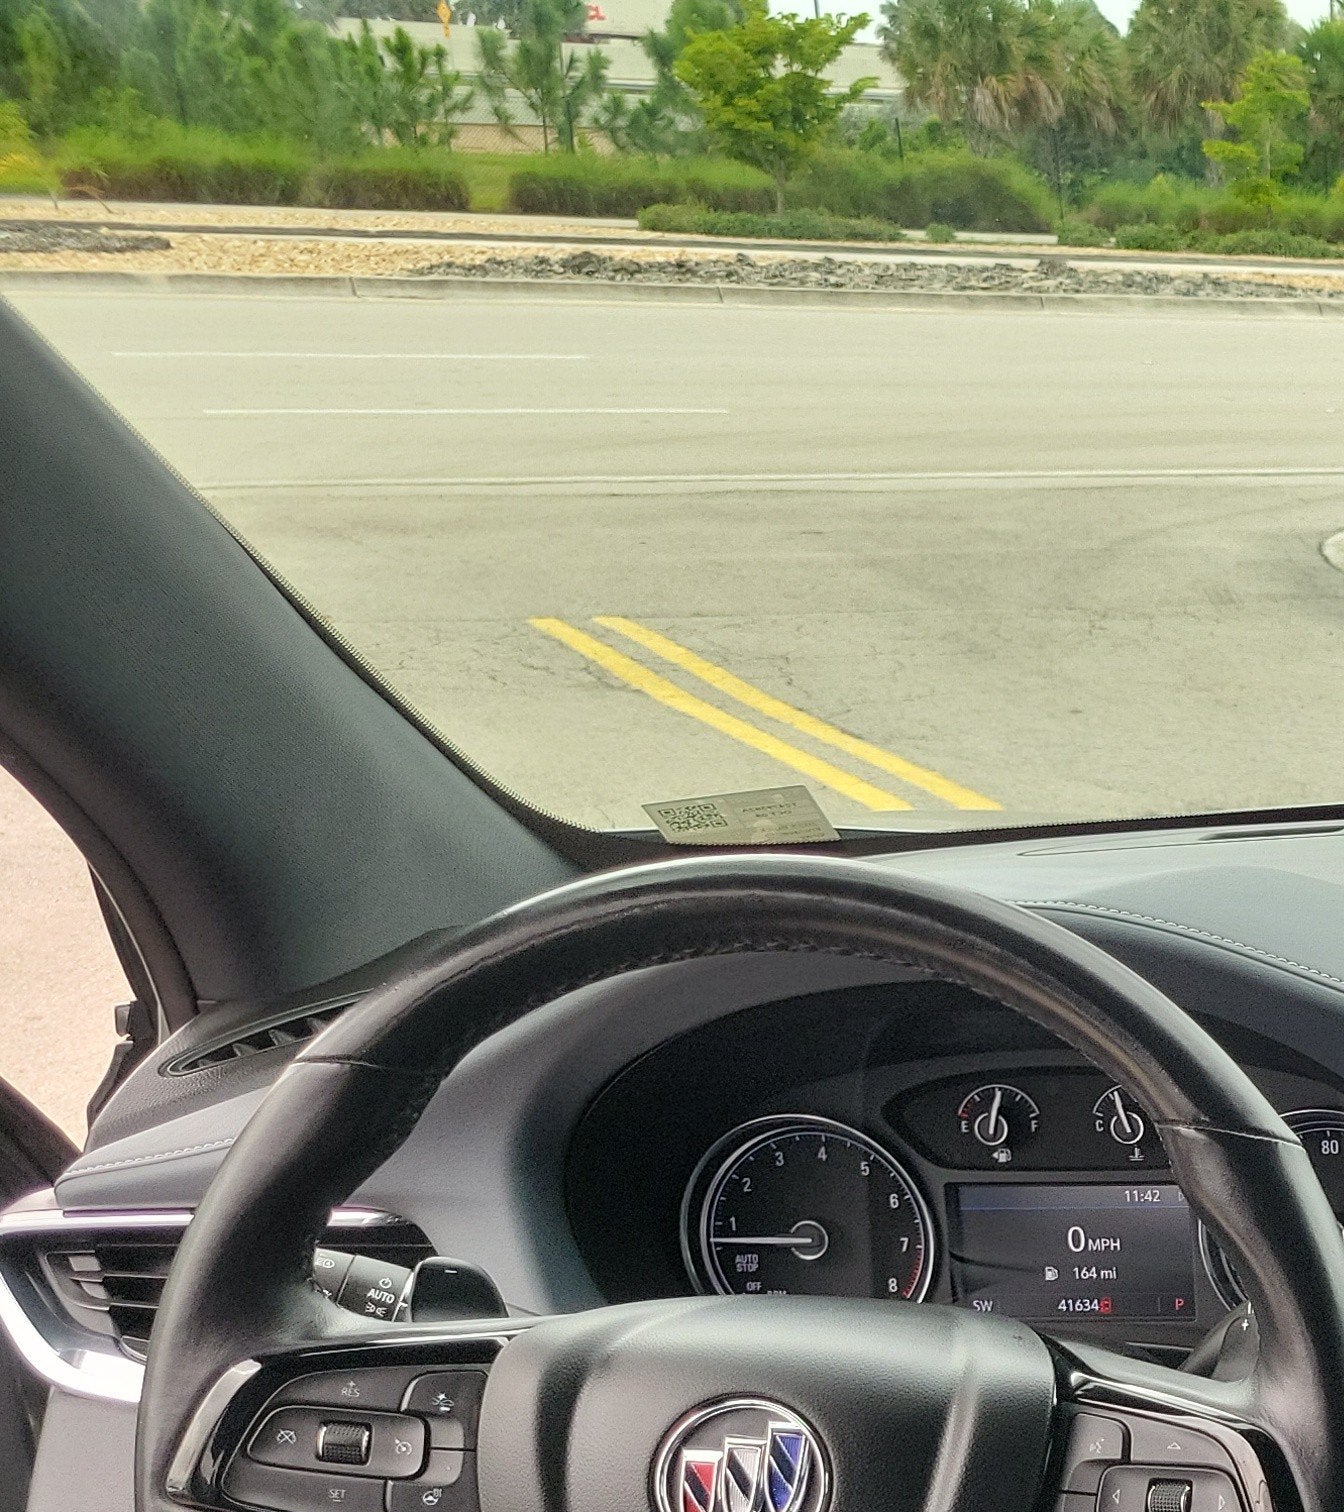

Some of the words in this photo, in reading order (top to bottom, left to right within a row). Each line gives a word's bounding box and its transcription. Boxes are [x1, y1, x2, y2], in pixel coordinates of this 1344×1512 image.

[817, 1147, 828, 1161] 4
[1321, 1140, 1340, 1155] 80
[774, 1152, 785, 1167] 3
[860, 1161, 870, 1176] 5
[741, 1177, 752, 1192] 2
[889, 1194, 899, 1208] 6
[1124, 1190, 1161, 1202] 11:42
[729, 1217, 737, 1231] 1
[900, 1237, 909, 1252] 7
[1067, 1226, 1086, 1252] 0
[1088, 1238, 1121, 1252] MPH
[735, 1253, 759, 1264] AUTO
[736, 1263, 759, 1273] STOP
[1072, 1267, 1098, 1280] 164
[1100, 1267, 1117, 1280] mi
[888, 1278, 898, 1292] 8
[366, 1288, 395, 1304] AUTO
[972, 1300, 993, 1312] SW
[1058, 1299, 1100, 1313] 41634
[1175, 1298, 1184, 1310] P
[329, 1488, 346, 1499] SET
